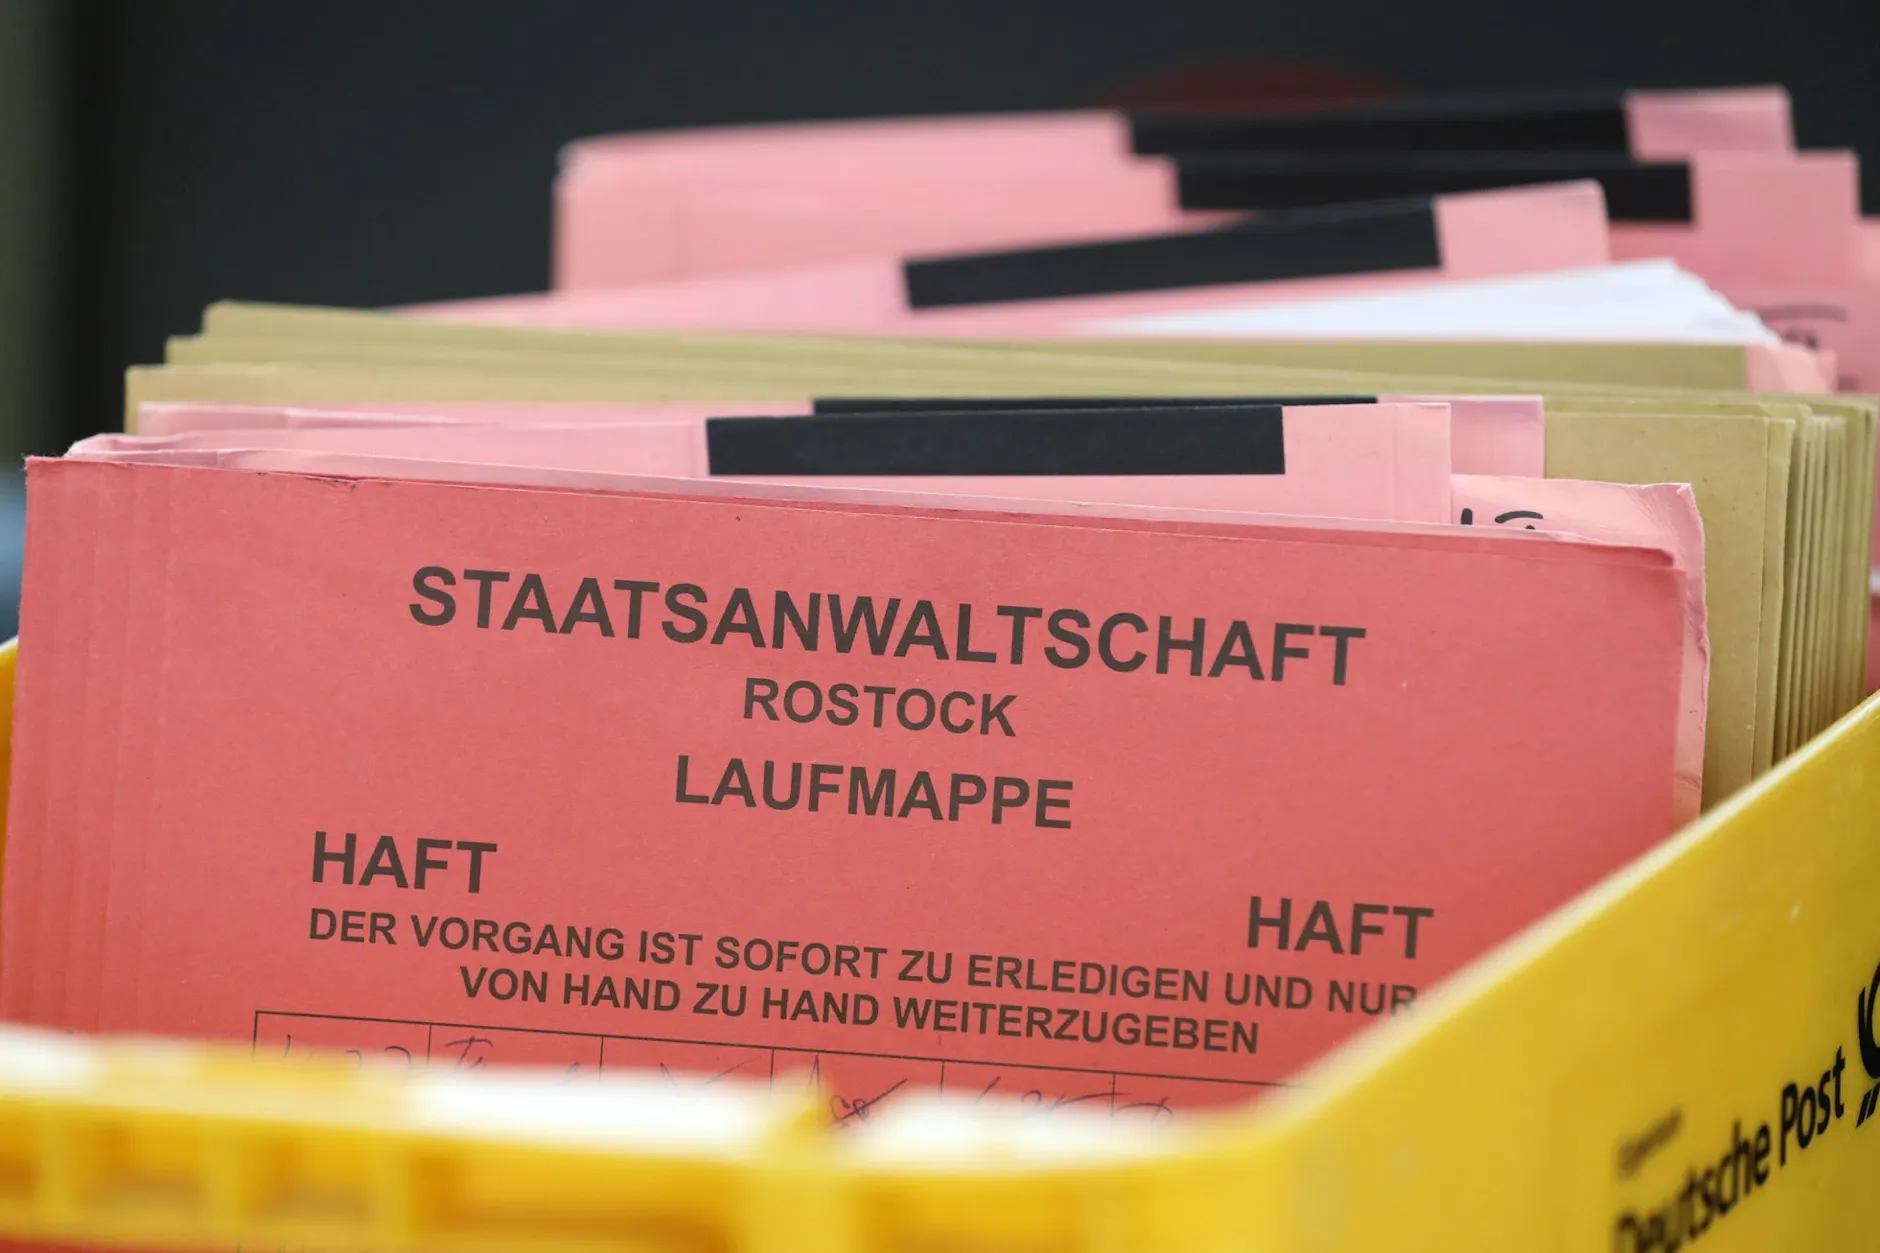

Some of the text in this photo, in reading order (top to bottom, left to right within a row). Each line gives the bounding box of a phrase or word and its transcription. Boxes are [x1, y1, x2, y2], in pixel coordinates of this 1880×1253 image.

[408, 565, 1367, 686] STAATSANWALTSCHAFT
[743, 677, 1017, 737] ROSTOCK
[675, 754, 1074, 830] LAUFMAPPE
[312, 830, 498, 894] HAFT
[309, 907, 1418, 1016] DER VORGANG IST SOFORT ZU ERLEDIGEN UND NUR
[1247, 895, 1435, 960] HAFT
[459, 965, 1258, 1054] VON HAND ZU HAND WEITERZUGEBEN
[1780, 1045, 1846, 1167] Post
